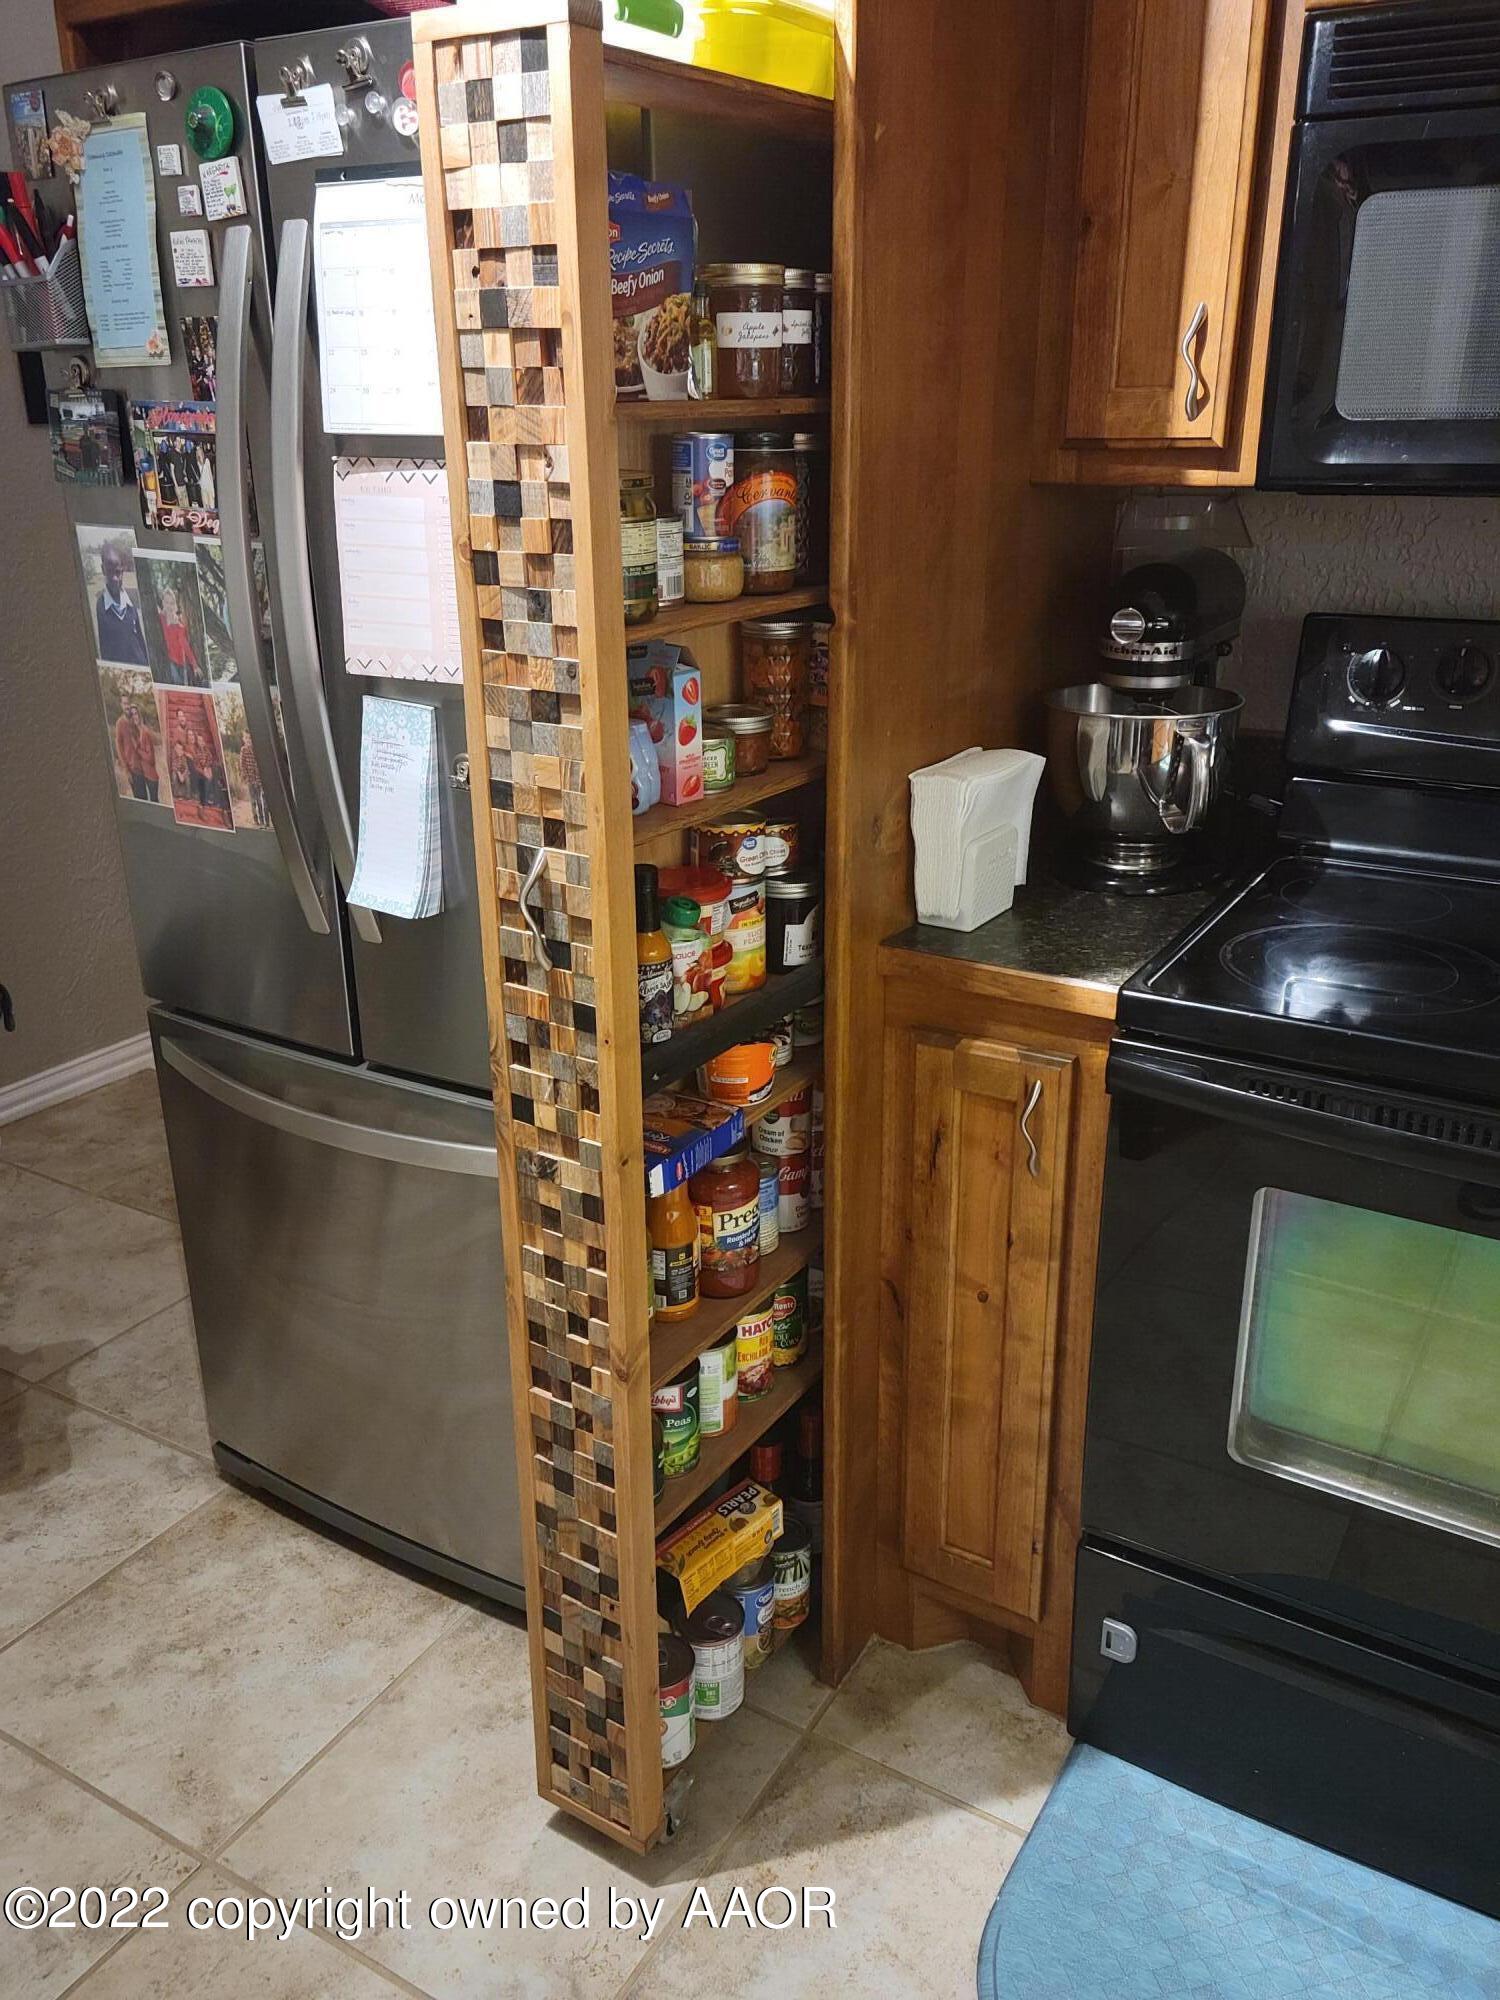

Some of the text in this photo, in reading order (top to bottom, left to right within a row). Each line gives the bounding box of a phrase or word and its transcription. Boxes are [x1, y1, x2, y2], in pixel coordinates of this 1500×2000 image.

[637, 238, 673, 264] Secrets
[611, 268, 664, 297] Beefy Onion
[759, 1135, 783, 1145] Chicken
[718, 1204, 759, 1232] Preg
[741, 1317, 772, 1337] HATC
[651, 1395, 676, 1407] ibby's
[666, 1416, 692, 1428] Peas
[718, 1486, 758, 1516] PEARLS
